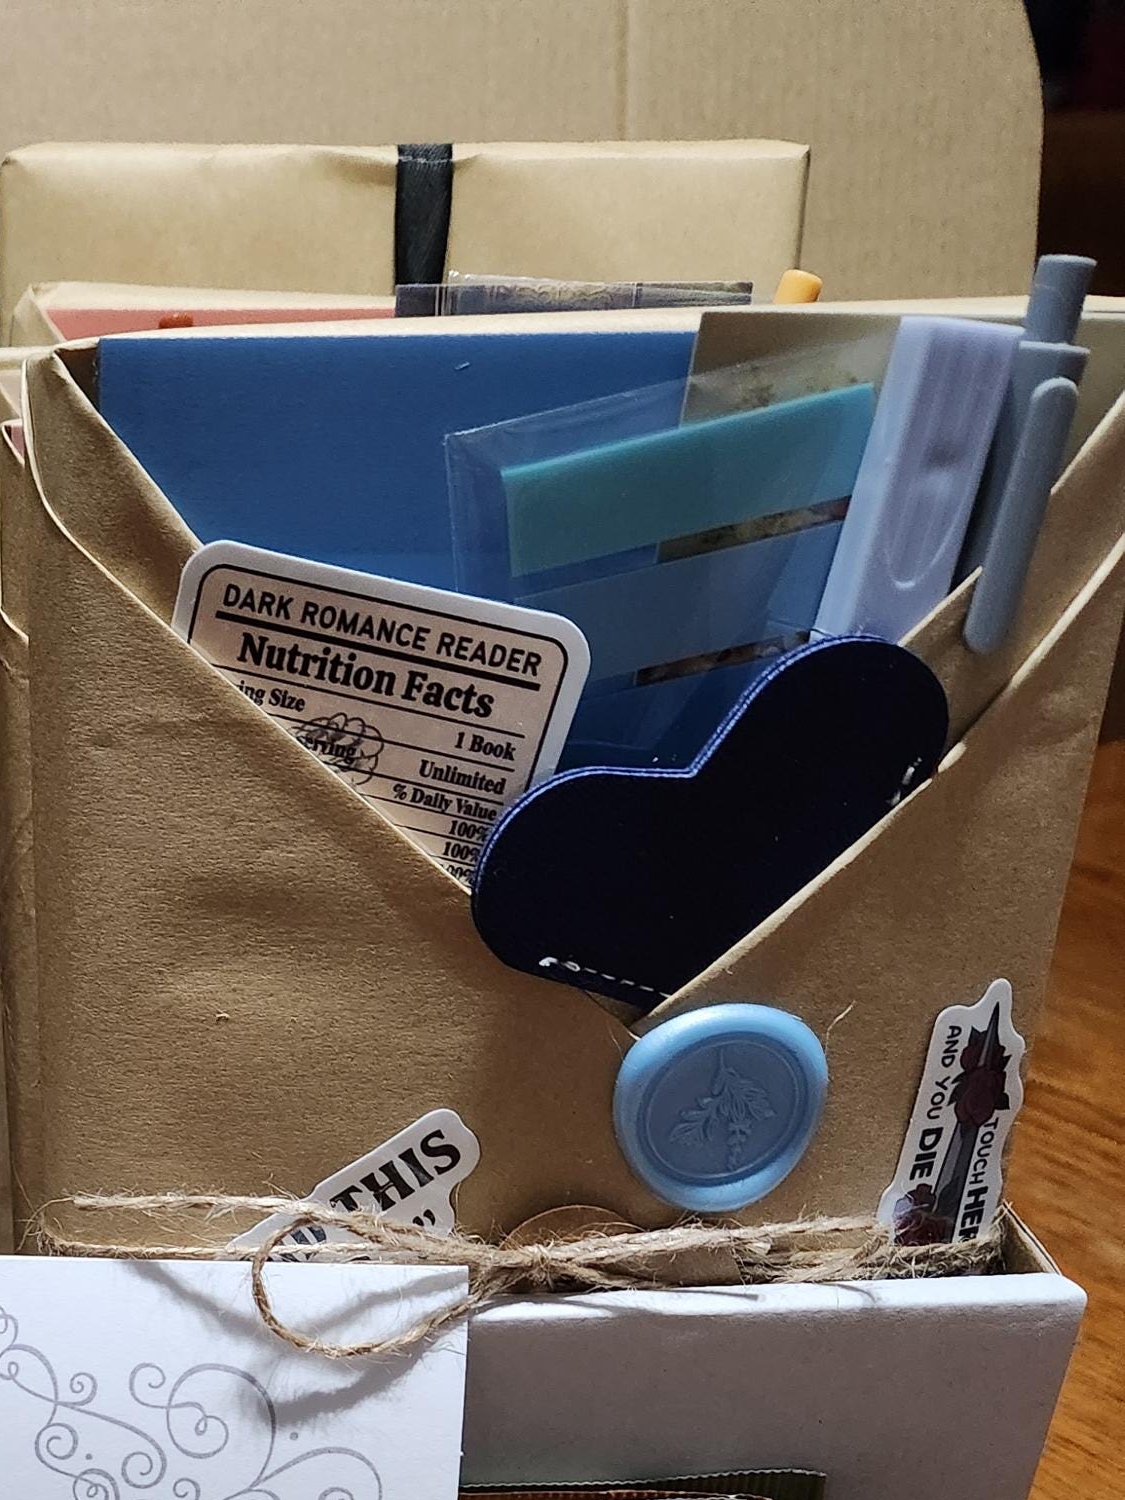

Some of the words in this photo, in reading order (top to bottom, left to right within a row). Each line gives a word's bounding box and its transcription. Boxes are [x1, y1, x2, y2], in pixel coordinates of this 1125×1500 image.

[223, 583, 293, 620] DARK
[301, 601, 431, 651] ROMANCE
[437, 632, 542, 677] READER
[237, 632, 396, 697] Nutrition
[400, 674, 495, 719] Facts
[269, 688, 306, 712] Size
[455, 732, 464, 749] 1
[470, 735, 517, 762] Book
[410, 788, 453, 814] Daily
[456, 798, 497, 821] Value
[419, 759, 507, 796] Unlimited
[941, 1025, 962, 1068] AND
[926, 1076, 952, 1120] YOU
[329, 1129, 462, 1212] THIS
[910, 1127, 945, 1181] DIE
[969, 1117, 1000, 1185] TOUCH
[959, 1186, 989, 1243] HER
